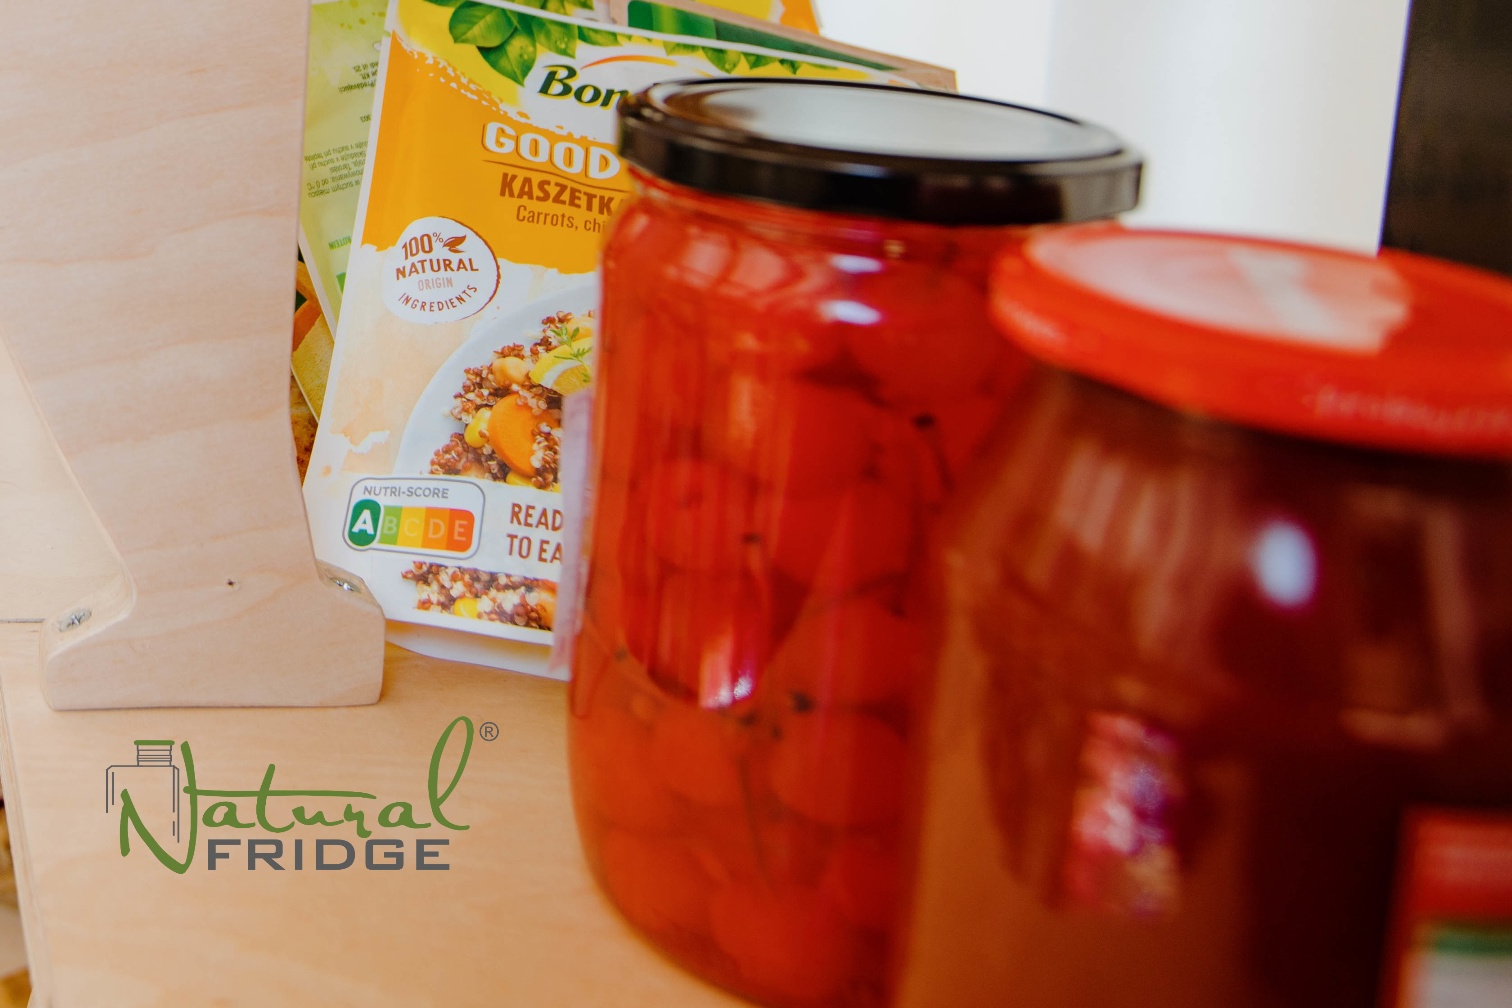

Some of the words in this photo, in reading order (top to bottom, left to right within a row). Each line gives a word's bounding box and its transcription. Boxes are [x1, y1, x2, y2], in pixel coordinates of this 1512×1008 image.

[482, 122, 620, 180] GOOD
[516, 204, 579, 231] Carrots,
[402, 232, 444, 261] 100%
[395, 258, 479, 281] NATURAL
[417, 277, 454, 291] ORIGIN
[397, 284, 478, 313] INGREDIENTS
[363, 485, 450, 500] NUTRI-SCORE
[507, 533, 532, 560] TO
